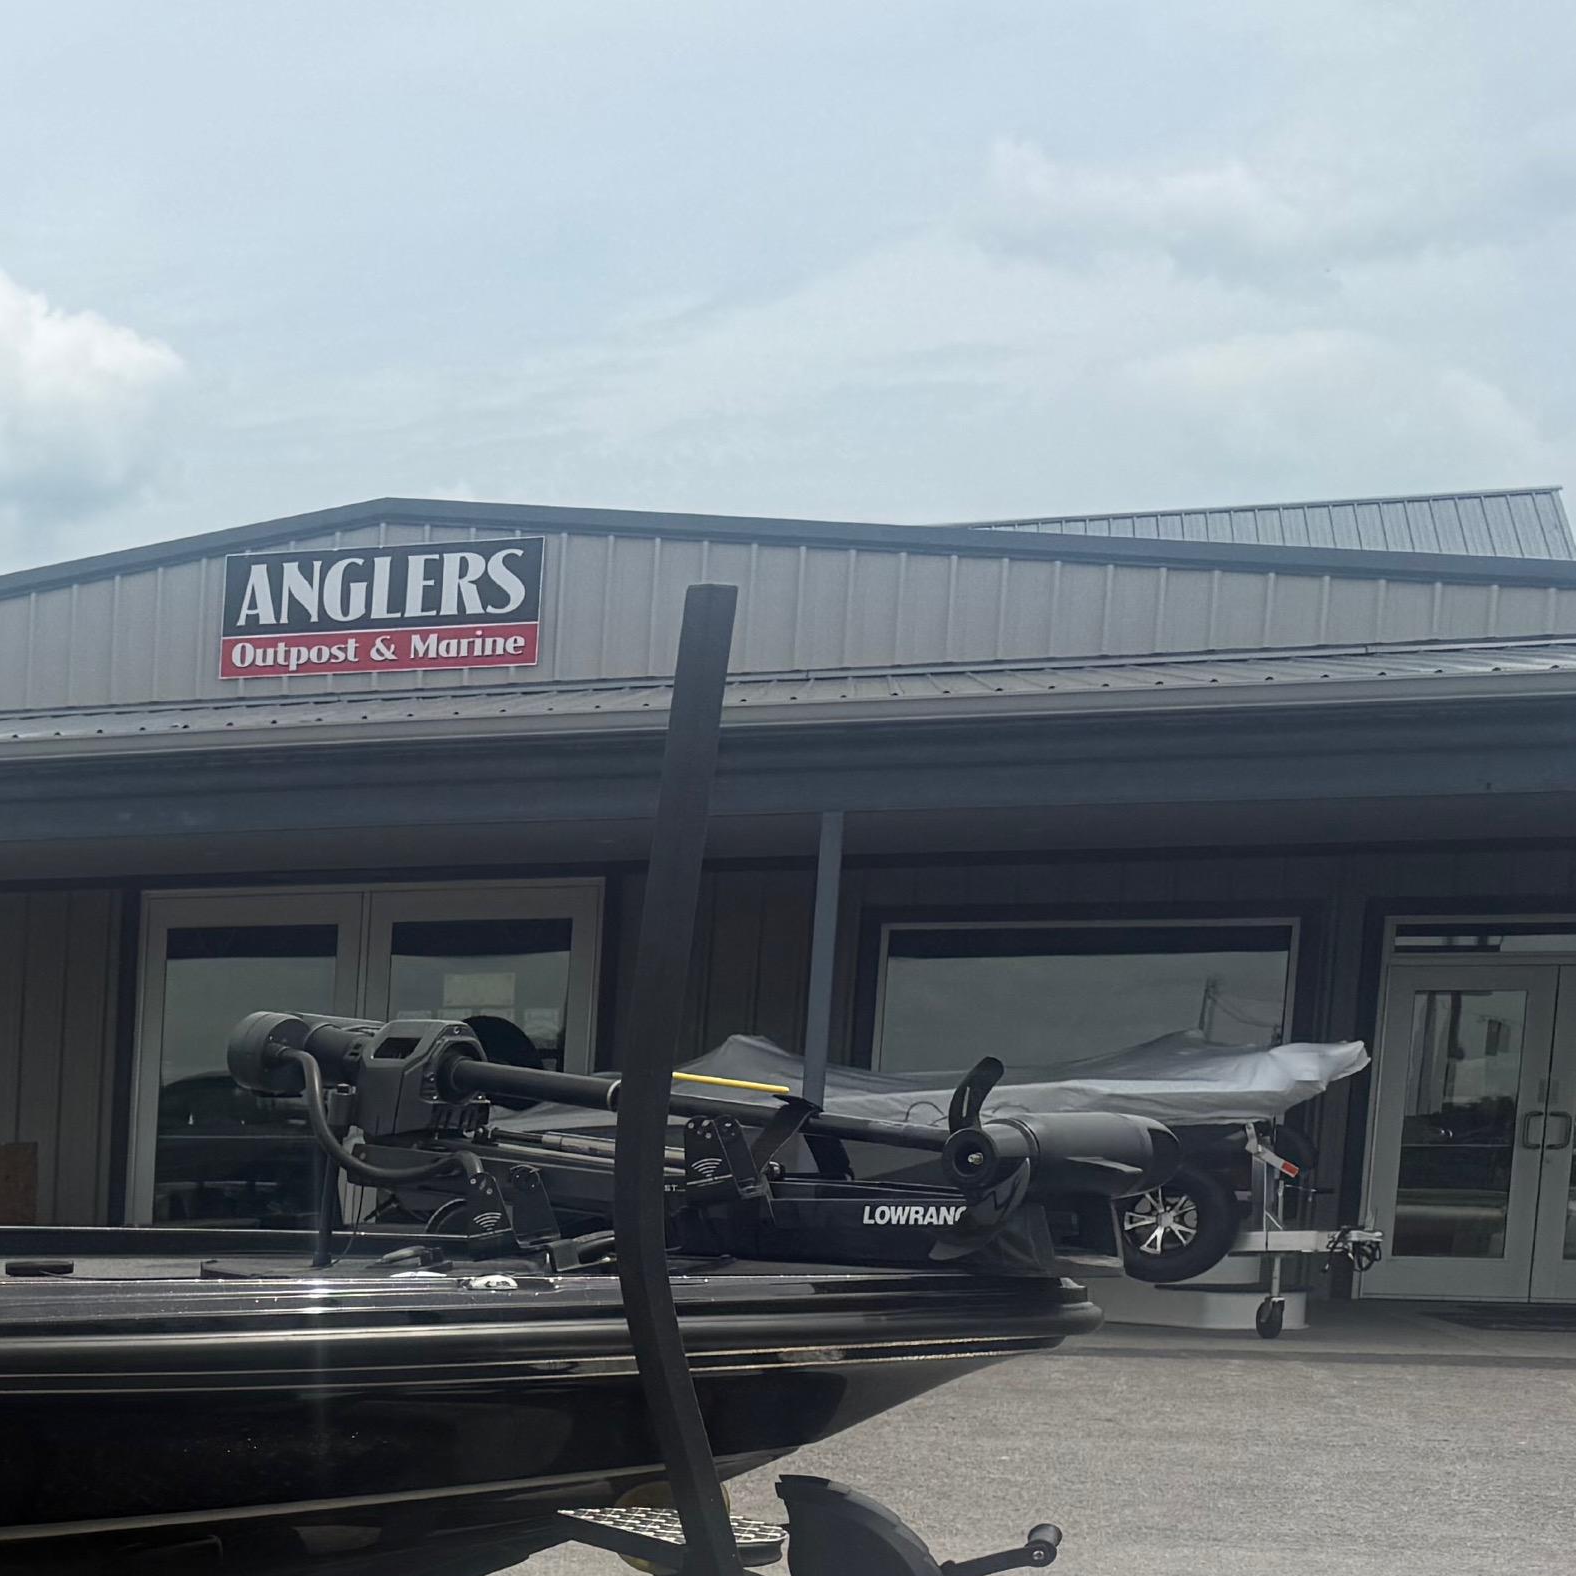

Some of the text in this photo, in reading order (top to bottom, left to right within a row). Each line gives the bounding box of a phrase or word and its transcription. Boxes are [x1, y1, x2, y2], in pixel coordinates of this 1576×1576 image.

[236, 548, 527, 626] ANGLERS
[231, 630, 526, 671] Outpost & Marine
